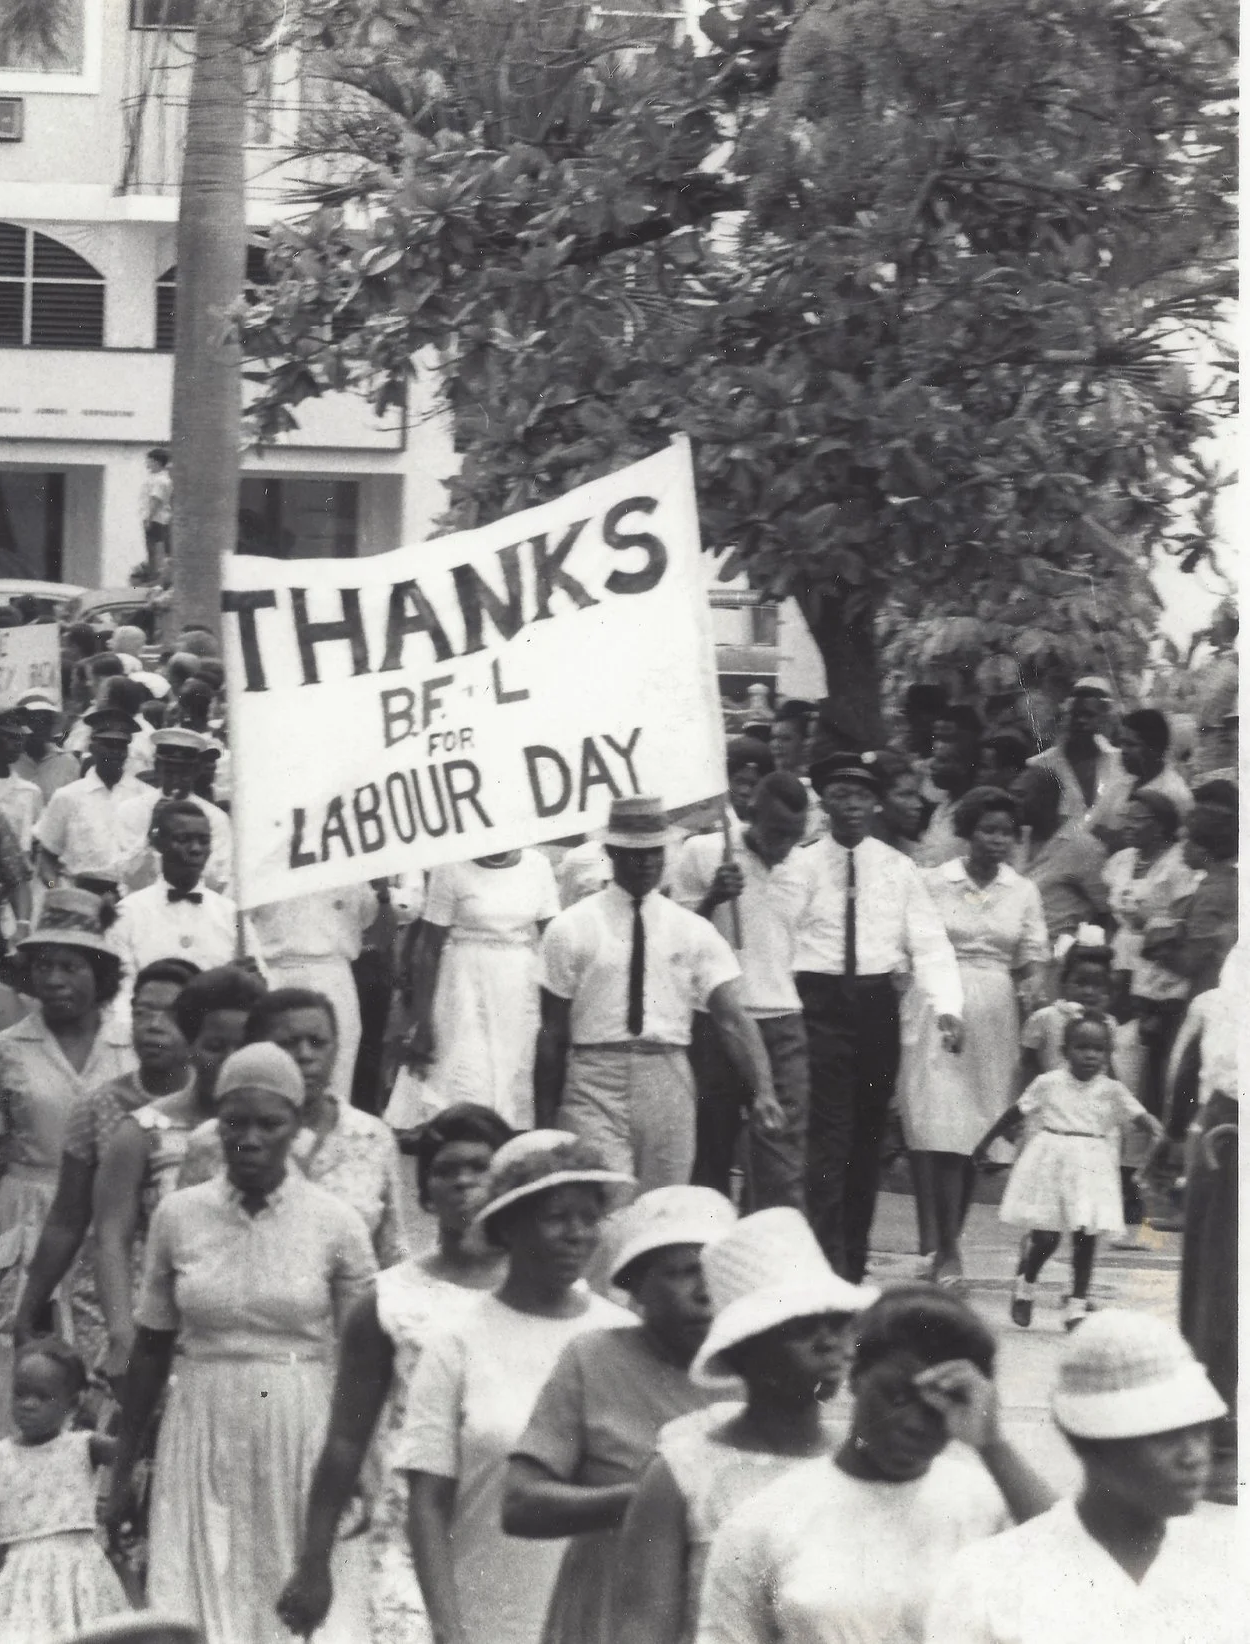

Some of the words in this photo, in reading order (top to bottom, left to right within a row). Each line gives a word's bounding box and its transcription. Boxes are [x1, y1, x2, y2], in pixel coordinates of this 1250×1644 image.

[222, 496, 668, 692] THANKS
[288, 759, 494, 869] LABOUR
[523, 727, 643, 819] DAY
[428, 727, 475, 757] FOR
